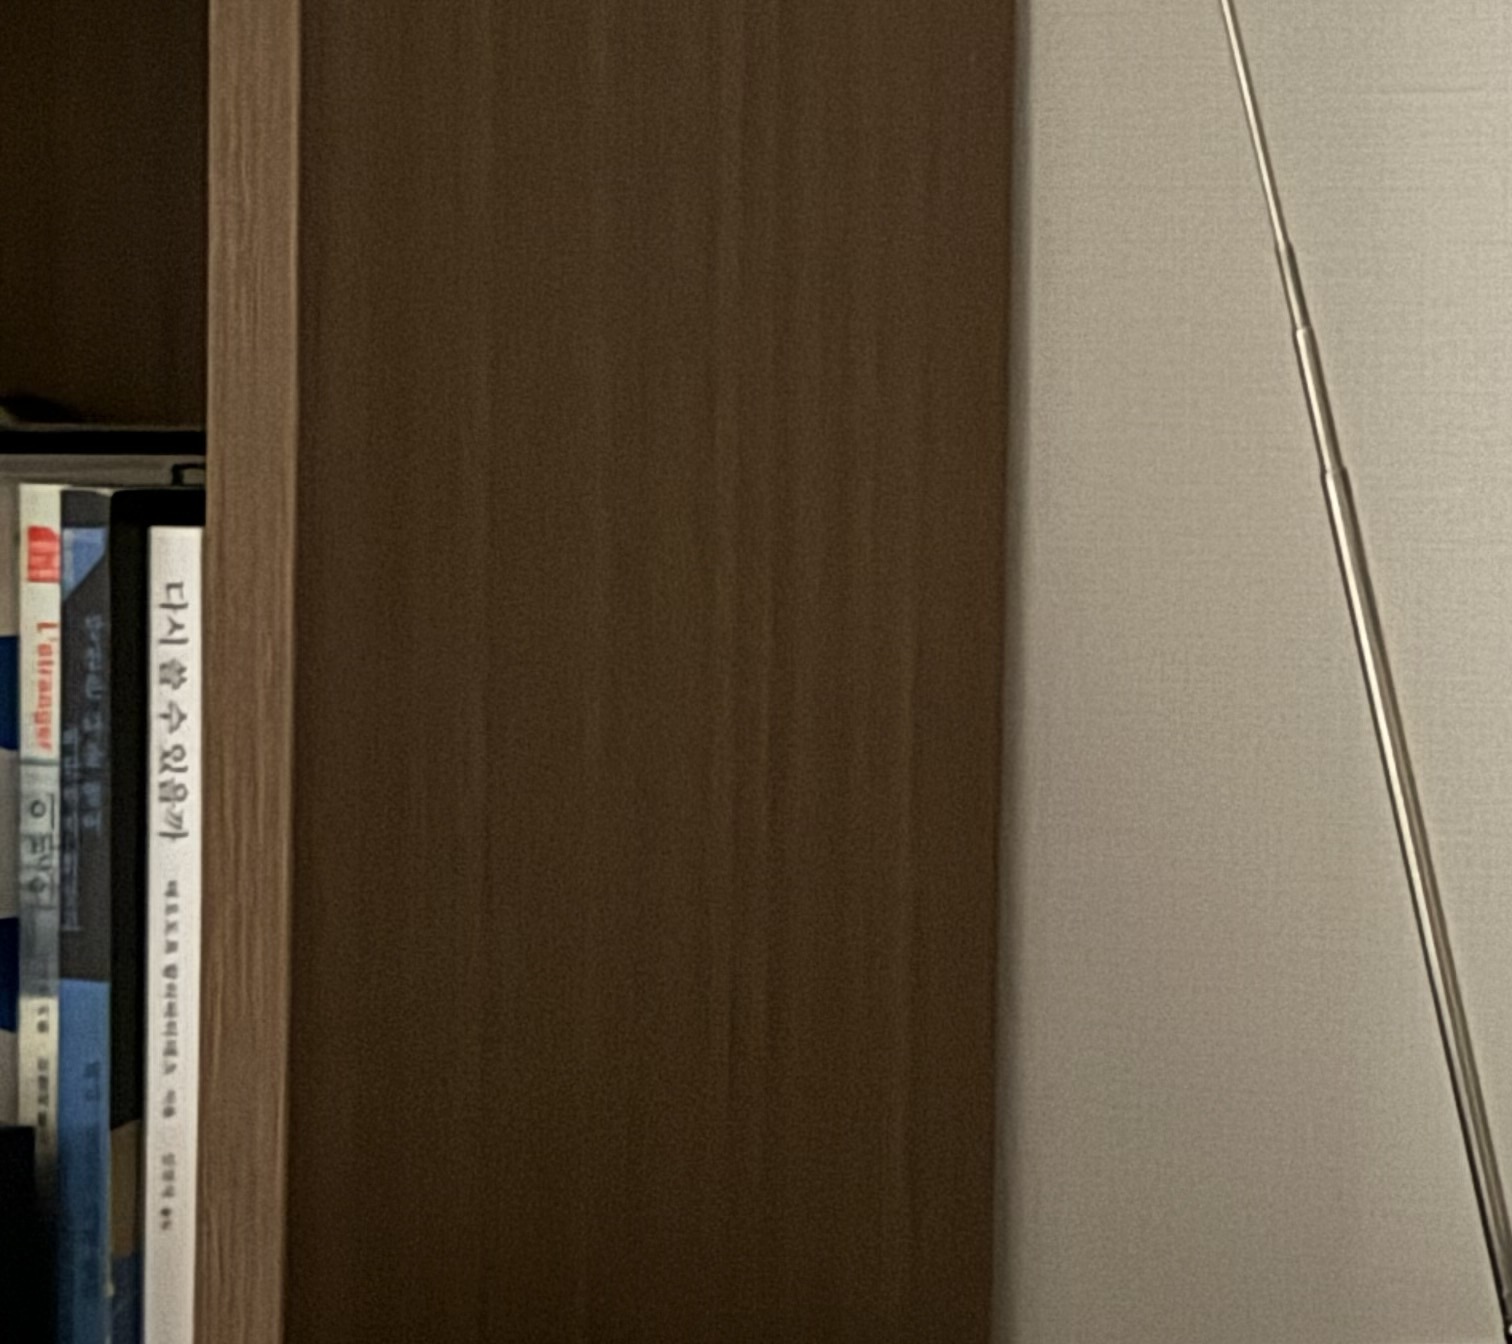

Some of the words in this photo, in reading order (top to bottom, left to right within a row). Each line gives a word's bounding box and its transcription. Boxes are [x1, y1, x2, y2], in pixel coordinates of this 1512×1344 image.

[158, 582, 189, 645] 다시
[158, 701, 188, 734] 수
[158, 744, 189, 840] 있을까
